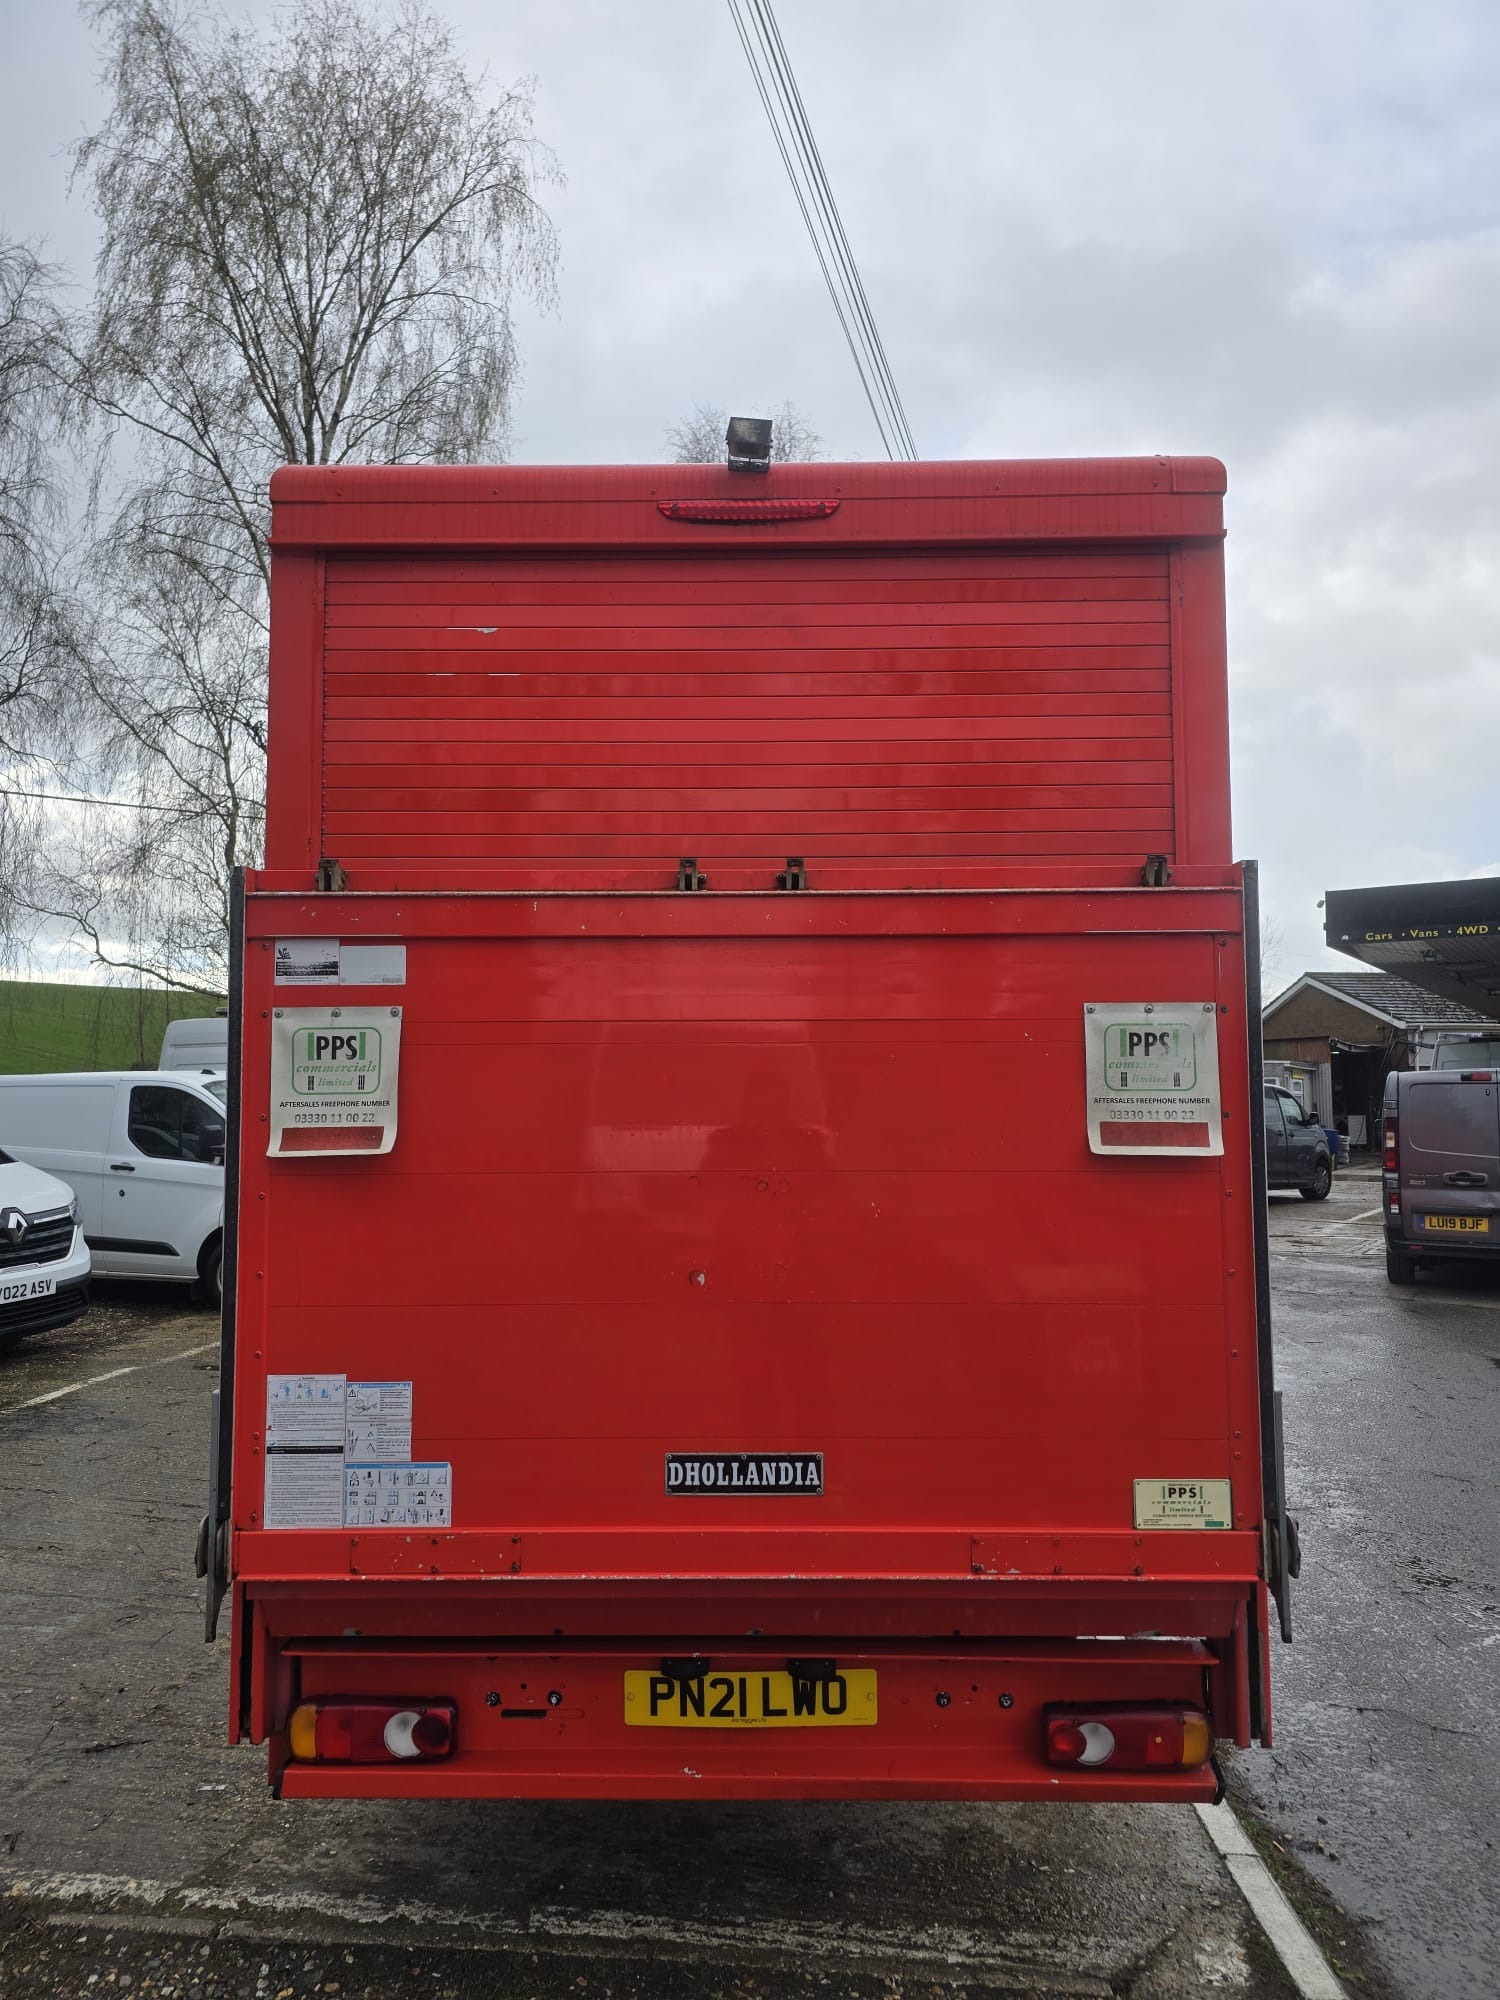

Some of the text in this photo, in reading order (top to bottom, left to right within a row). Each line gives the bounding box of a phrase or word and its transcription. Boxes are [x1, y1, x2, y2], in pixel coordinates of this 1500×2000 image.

[1365, 925, 1489, 941] Cars Vans 4WD
[316, 1035, 358, 1061] PPS
[1128, 1032, 1170, 1056] PPS
[296, 1060, 377, 1073] commercials
[319, 1077, 354, 1087] limited
[294, 1113, 375, 1123] 03330 11 00 22
[1110, 1110, 1195, 1120] 03330 11 00 22
[1429, 1217, 1484, 1230] LU19 BJF
[31, 1279, 52, 1295] ASV
[668, 1462, 820, 1486] DHOLLANDIA
[1168, 1487, 1197, 1498] PPS
[650, 1675, 848, 1718] PN21 LWO
